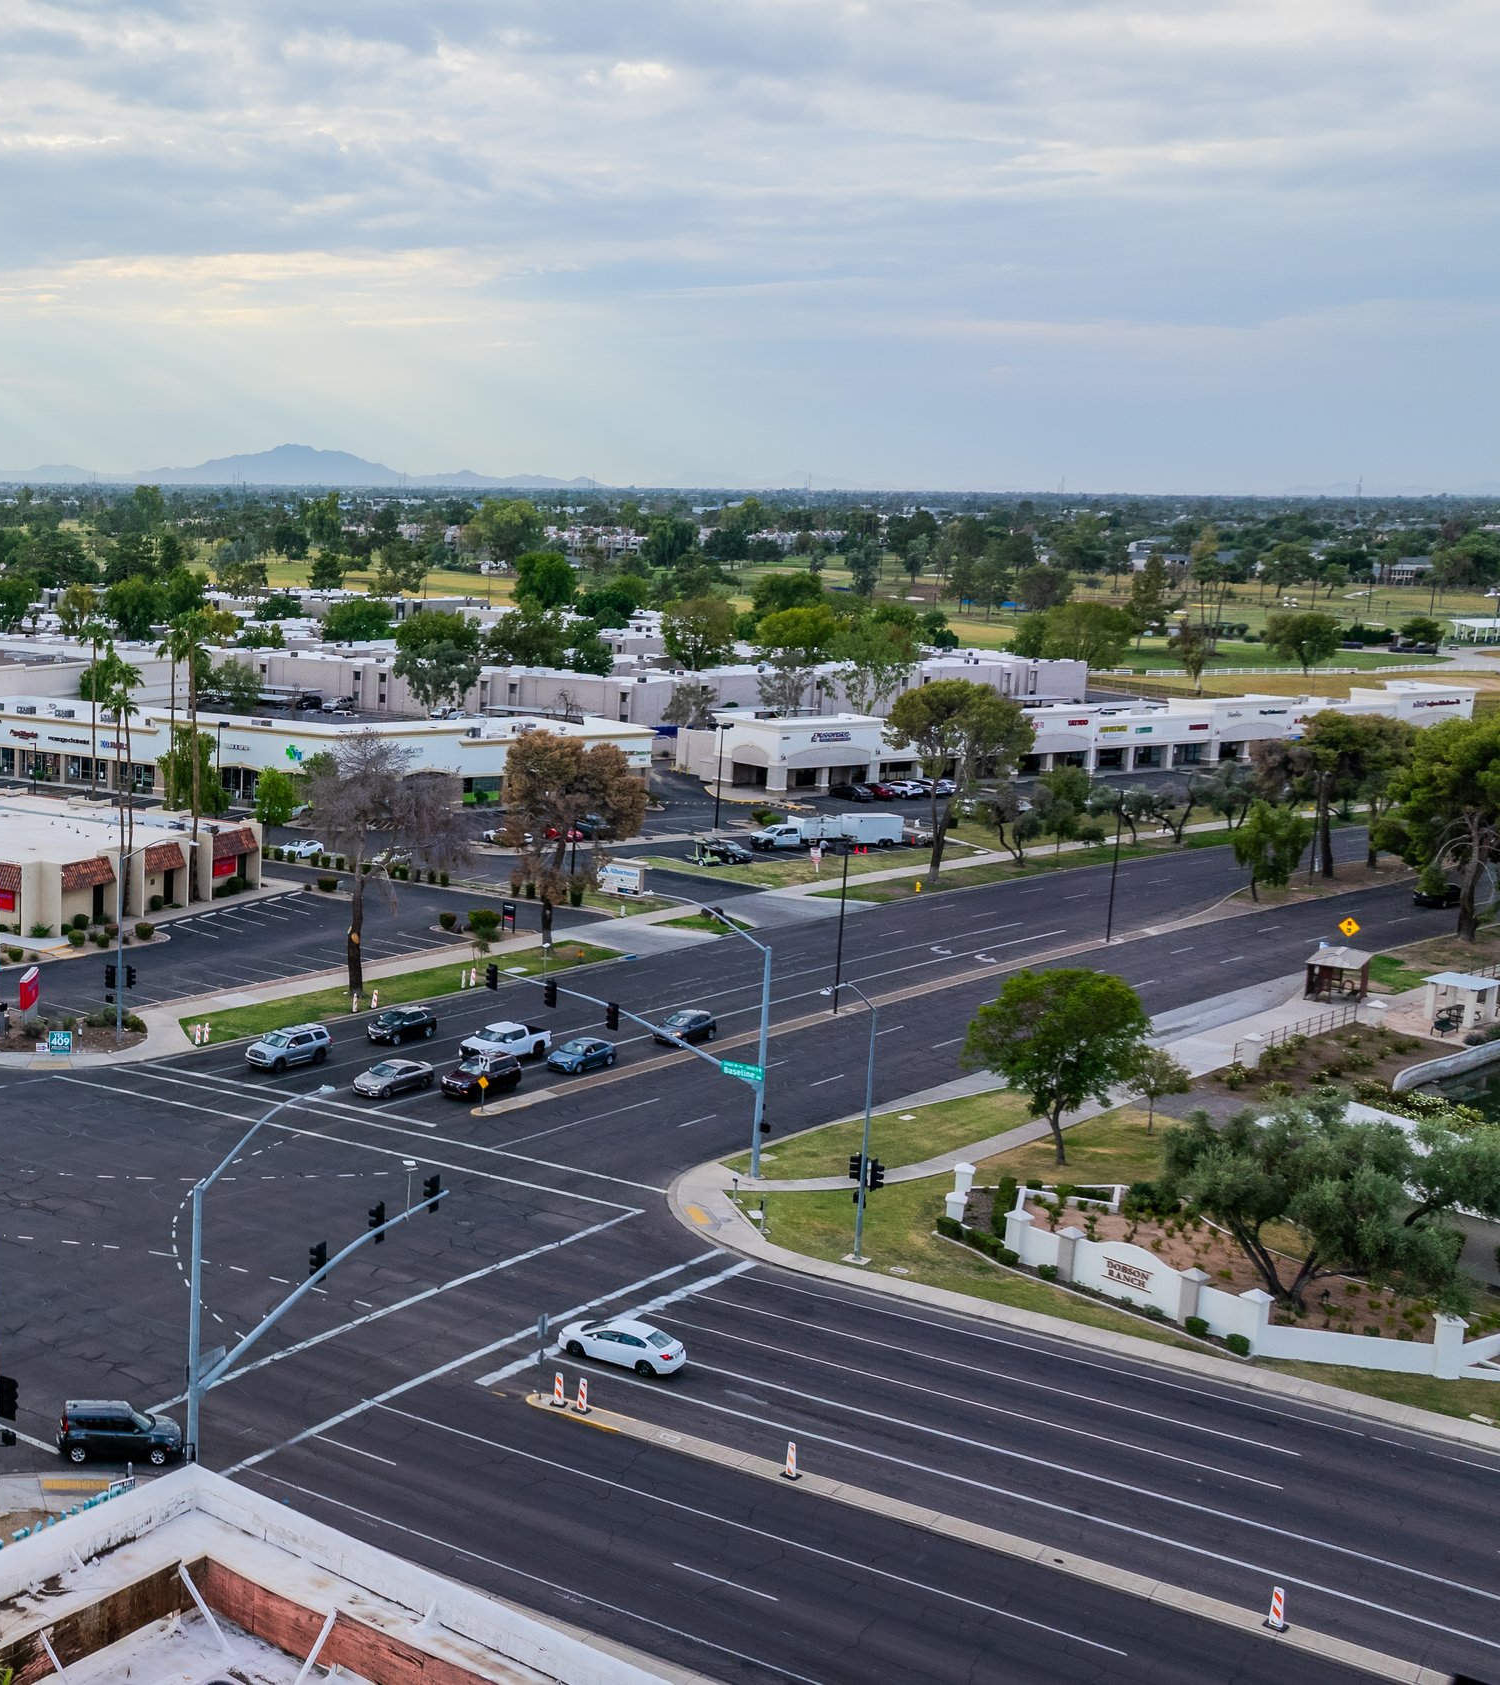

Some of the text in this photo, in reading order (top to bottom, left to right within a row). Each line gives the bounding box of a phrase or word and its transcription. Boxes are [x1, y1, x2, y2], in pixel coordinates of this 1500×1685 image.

[51, 1038, 70, 1046] 409
[724, 1066, 755, 1078] Baseline
[1107, 1260, 1149, 1281] DOBSON
[1108, 1269, 1146, 1288] RANCH
